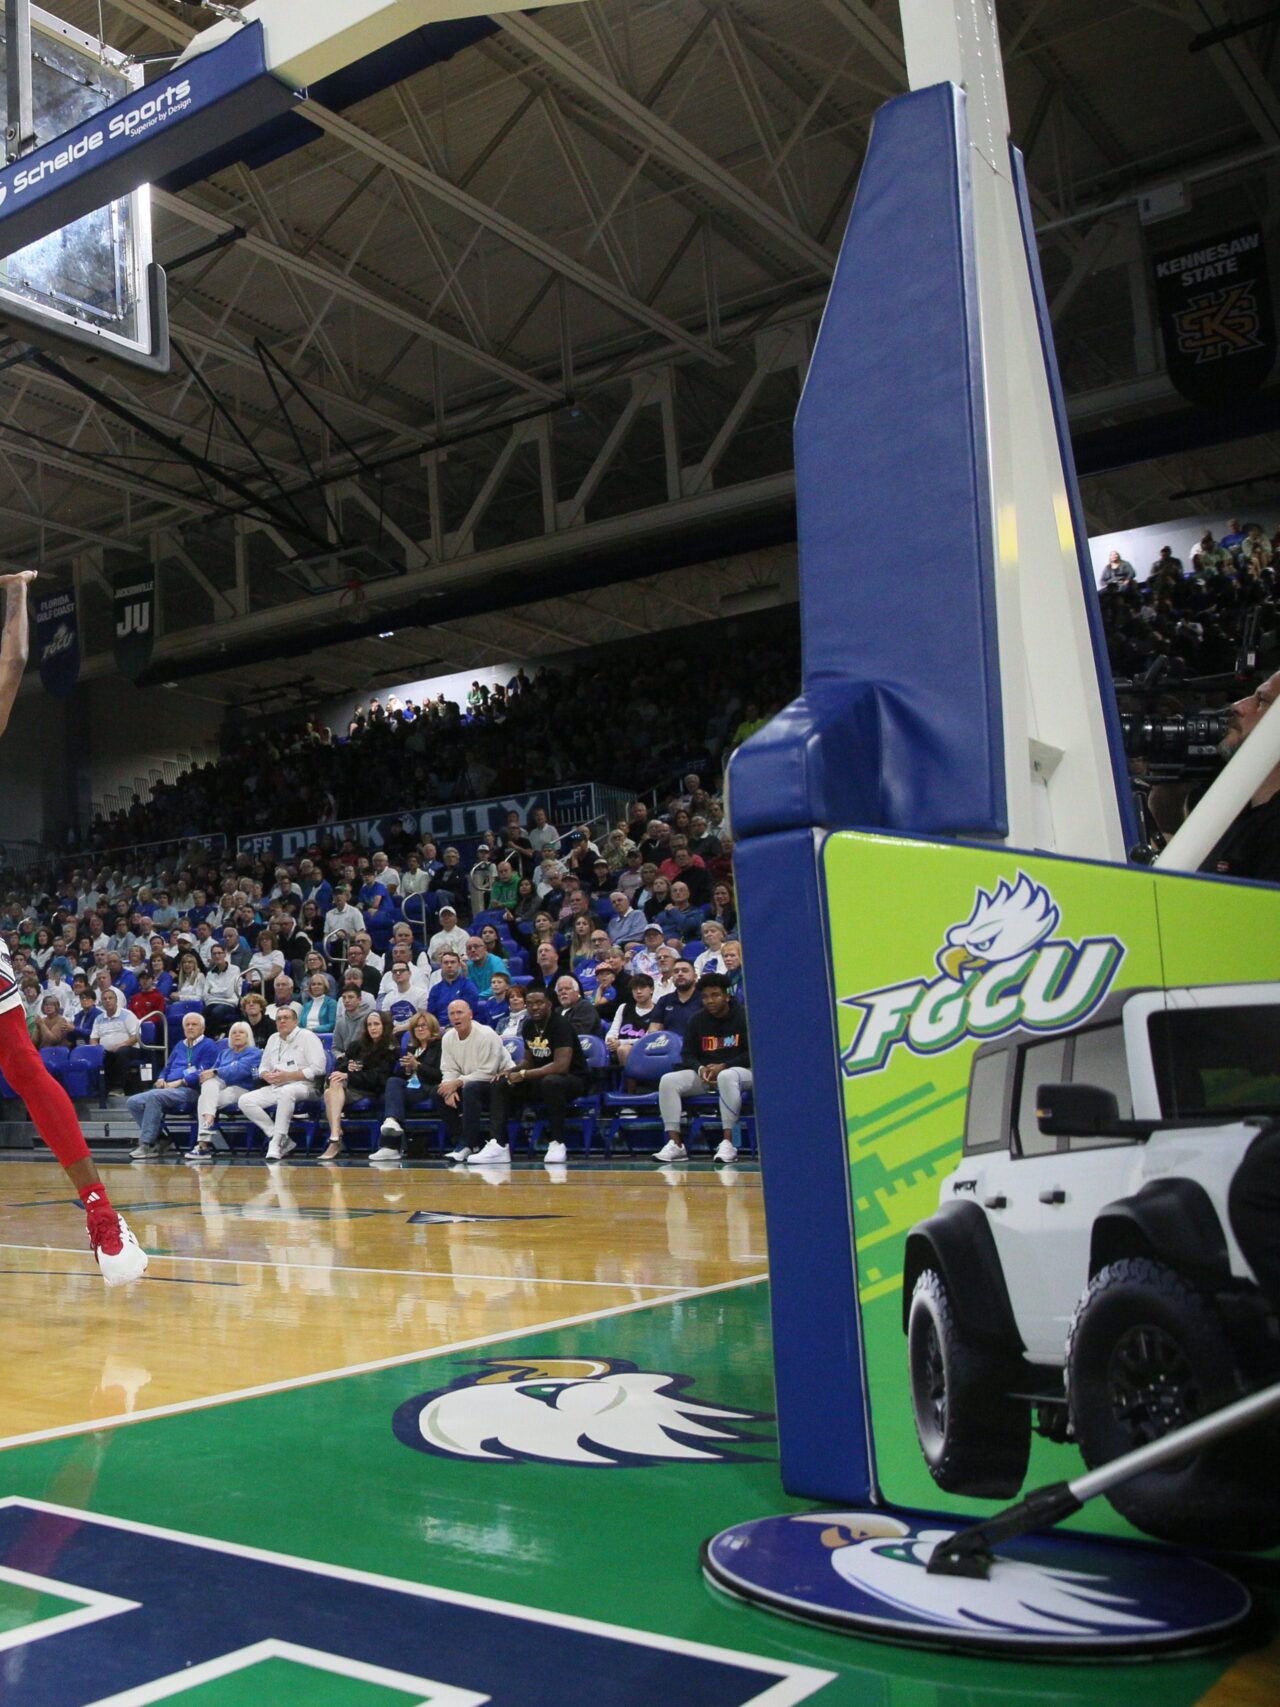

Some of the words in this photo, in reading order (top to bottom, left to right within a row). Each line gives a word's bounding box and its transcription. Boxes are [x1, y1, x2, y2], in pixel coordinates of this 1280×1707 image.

[14, 130, 104, 194] Schelde
[109, 79, 191, 139] Sports
[130, 117, 158, 138] Superior
[158, 111, 168, 122] by
[168, 98, 192, 113] Design
[1156, 233, 1260, 278] KENNESAW
[1181, 257, 1238, 287] STATE
[37, 609, 55, 623] GULF
[53, 602, 76, 618] COAST
[40, 594, 70, 612] FLORIDA
[116, 601, 150, 638] JU
[420, 796, 539, 839] CITY
[840, 937, 1125, 1078] FGCU
